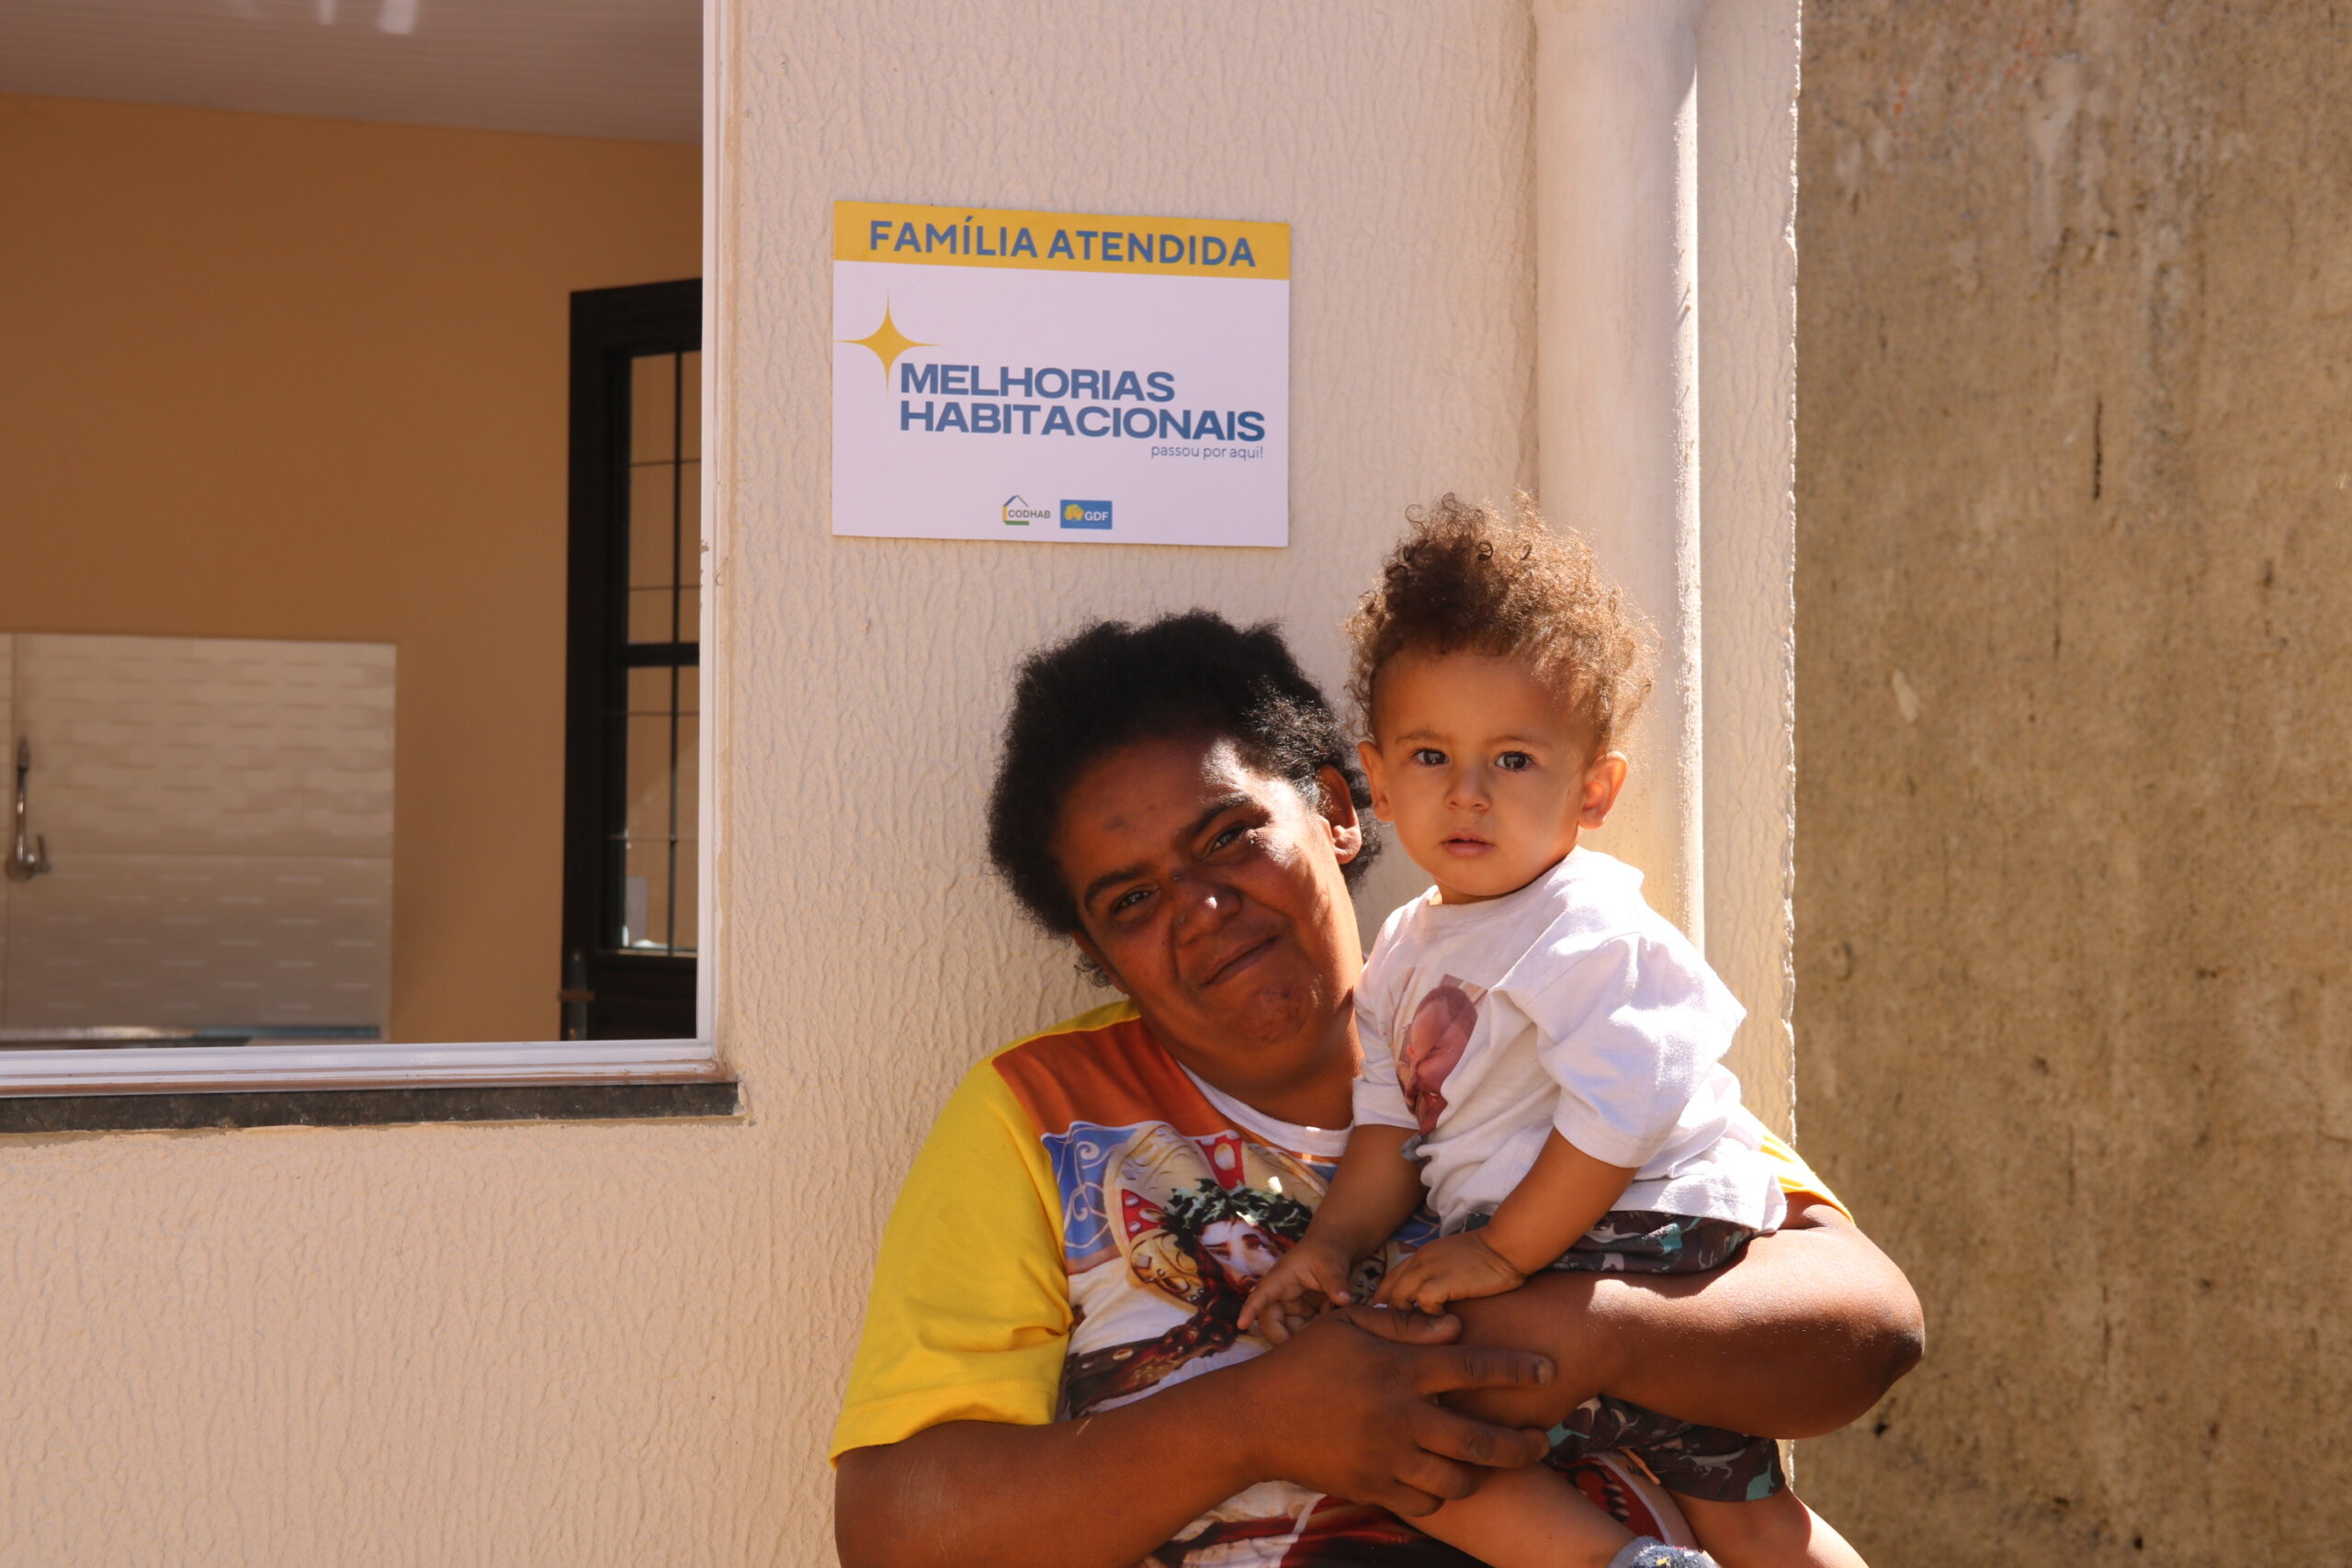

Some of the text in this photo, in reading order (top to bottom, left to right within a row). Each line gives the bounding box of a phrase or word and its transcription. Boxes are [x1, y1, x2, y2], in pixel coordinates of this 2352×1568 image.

[870, 215, 1256, 267] FAMÍLIA ATENDIDA
[900, 363, 1175, 402] MELHORIAS
[900, 400, 1265, 442] HABITACIONAIS
[1151, 446, 1263, 461] passou por aqui!
[1008, 509, 1051, 519] CODHAB
[1084, 511, 1109, 522] GDF
